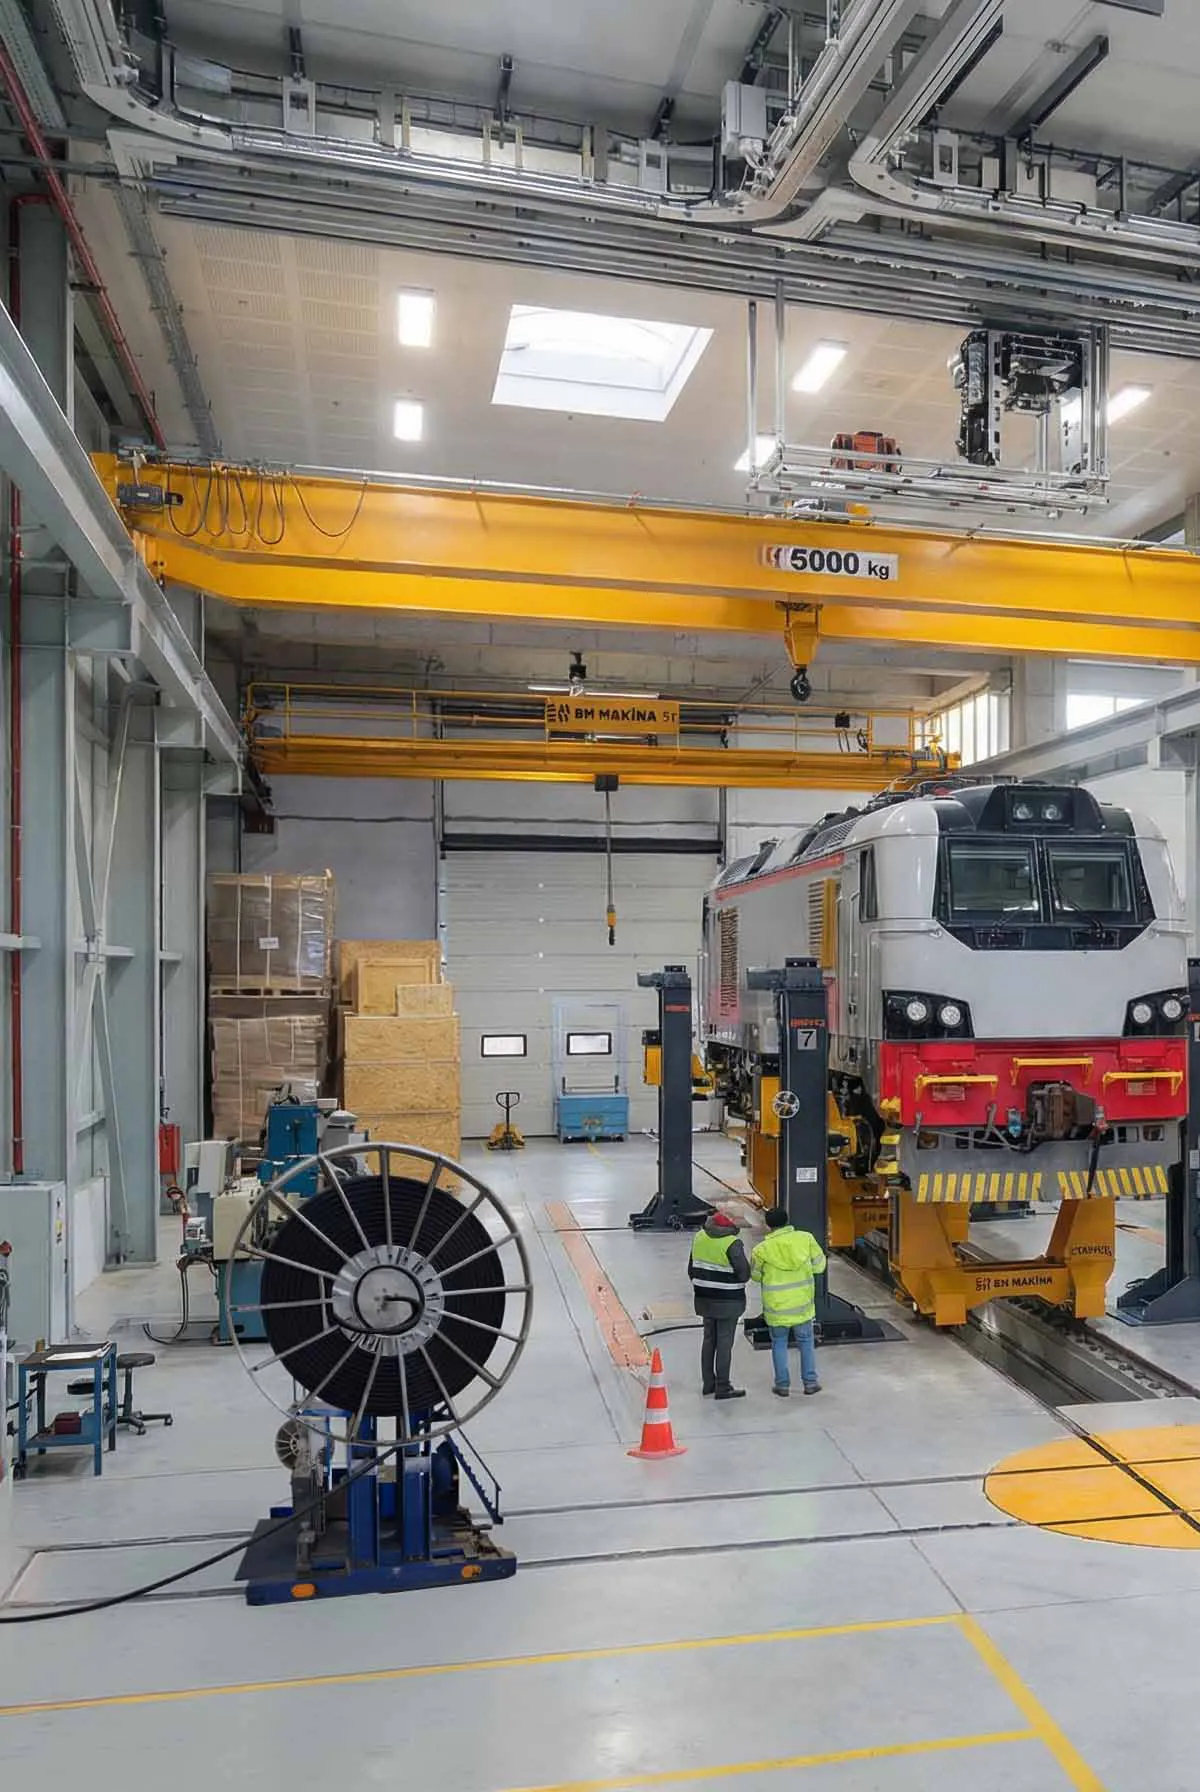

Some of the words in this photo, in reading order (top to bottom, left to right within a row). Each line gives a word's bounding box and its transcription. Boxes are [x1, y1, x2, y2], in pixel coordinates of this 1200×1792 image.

[790, 548, 860, 574] 5000
[867, 560, 890, 580] kg
[575, 707, 595, 720] BM
[800, 1031, 815, 1047] 7
